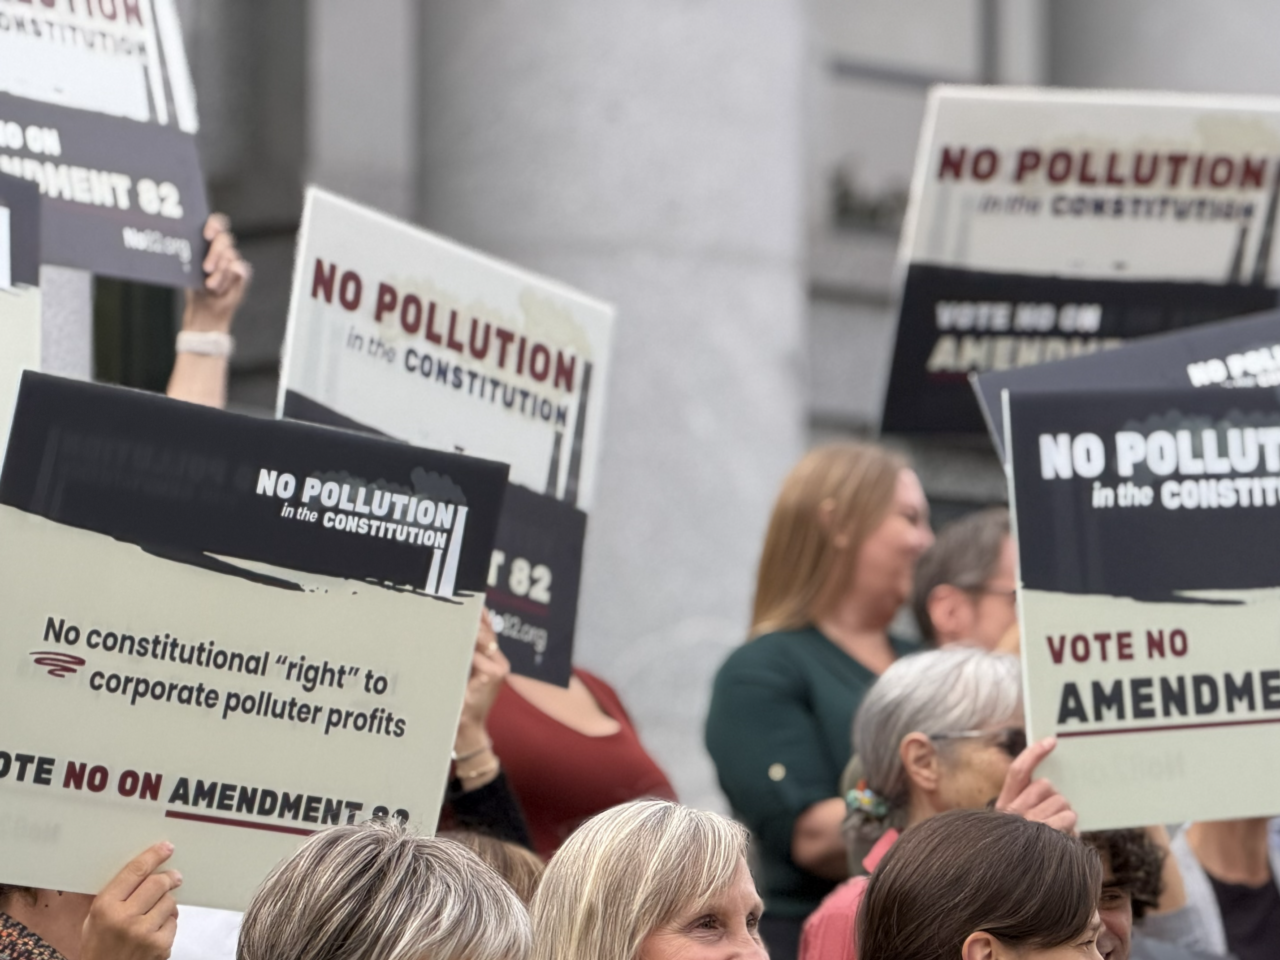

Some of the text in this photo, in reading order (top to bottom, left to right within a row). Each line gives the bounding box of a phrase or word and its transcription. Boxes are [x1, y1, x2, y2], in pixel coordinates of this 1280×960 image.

[25, 125, 62, 156] ON
[937, 146, 1269, 190] NO POLLUTION
[136, 178, 183, 219] 82
[1050, 195, 1256, 220] CONSTITUTION
[311, 258, 577, 393] NO POLLUTION
[935, 300, 1102, 334] VOTE NO ON
[347, 325, 568, 427] in the CONSTITUTION
[1187, 358, 1228, 387] NO
[1039, 433, 1105, 479] NO
[256, 468, 453, 531] NO POLLUTION
[1092, 482, 1116, 508] in
[1119, 482, 1154, 507] the
[281, 502, 447, 549] in the CONSTITUTION
[508, 556, 552, 604] 82
[489, 609, 548, 654] o82.org
[1046, 629, 1189, 665] VOTE NO
[43, 617, 81, 646] No
[86, 627, 270, 677] constitutional
[364, 672, 389, 696] to
[89, 670, 407, 738] corporate polluter profits
[62, 760, 109, 793] NO
[117, 769, 163, 801] ON
[167, 777, 364, 826] AMENDMENT
